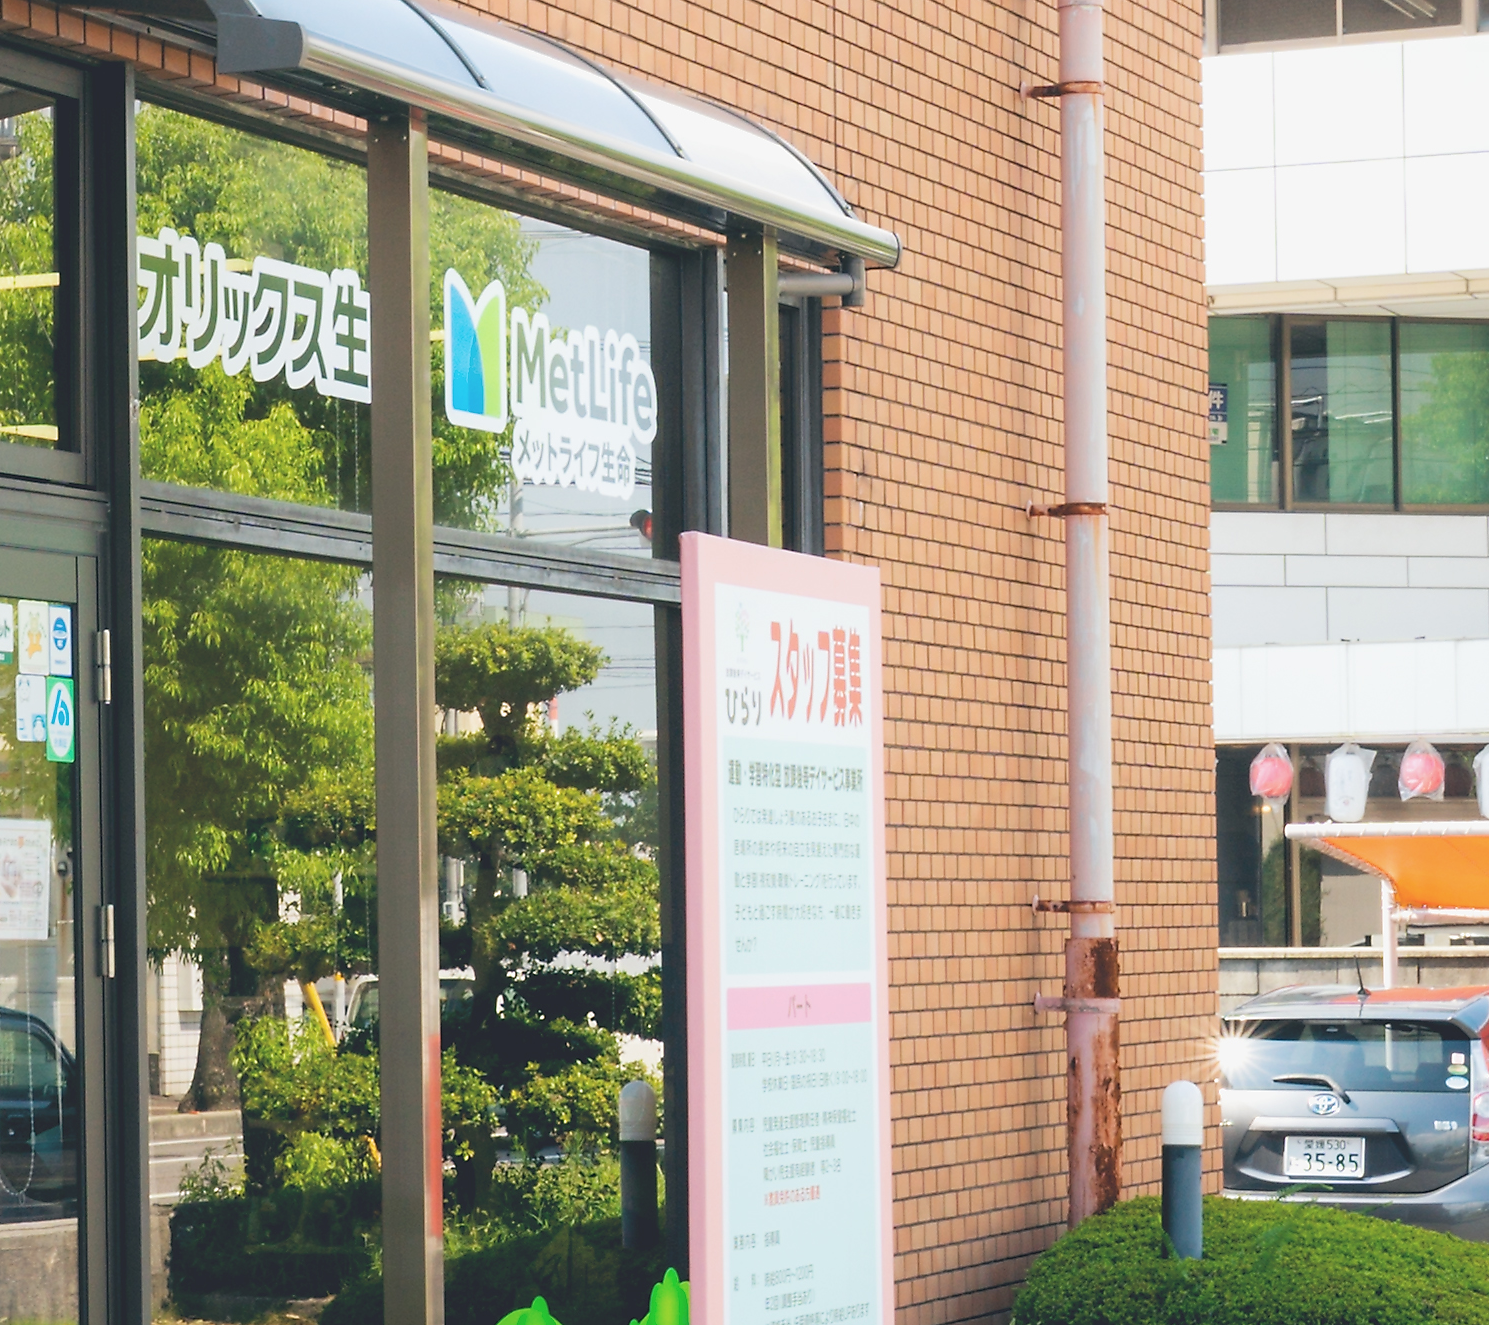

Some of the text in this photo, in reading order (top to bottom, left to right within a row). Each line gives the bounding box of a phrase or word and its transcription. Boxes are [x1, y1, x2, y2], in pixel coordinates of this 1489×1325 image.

[516, 322, 652, 432] MetLife
[518, 429, 631, 488] メットライフ生命
[770, 618, 863, 727] スタッフ募集
[725, 686, 762, 726] ひらり
[788, 994, 812, 1018] パート
[1303, 1152, 1360, 1173] 35-85
